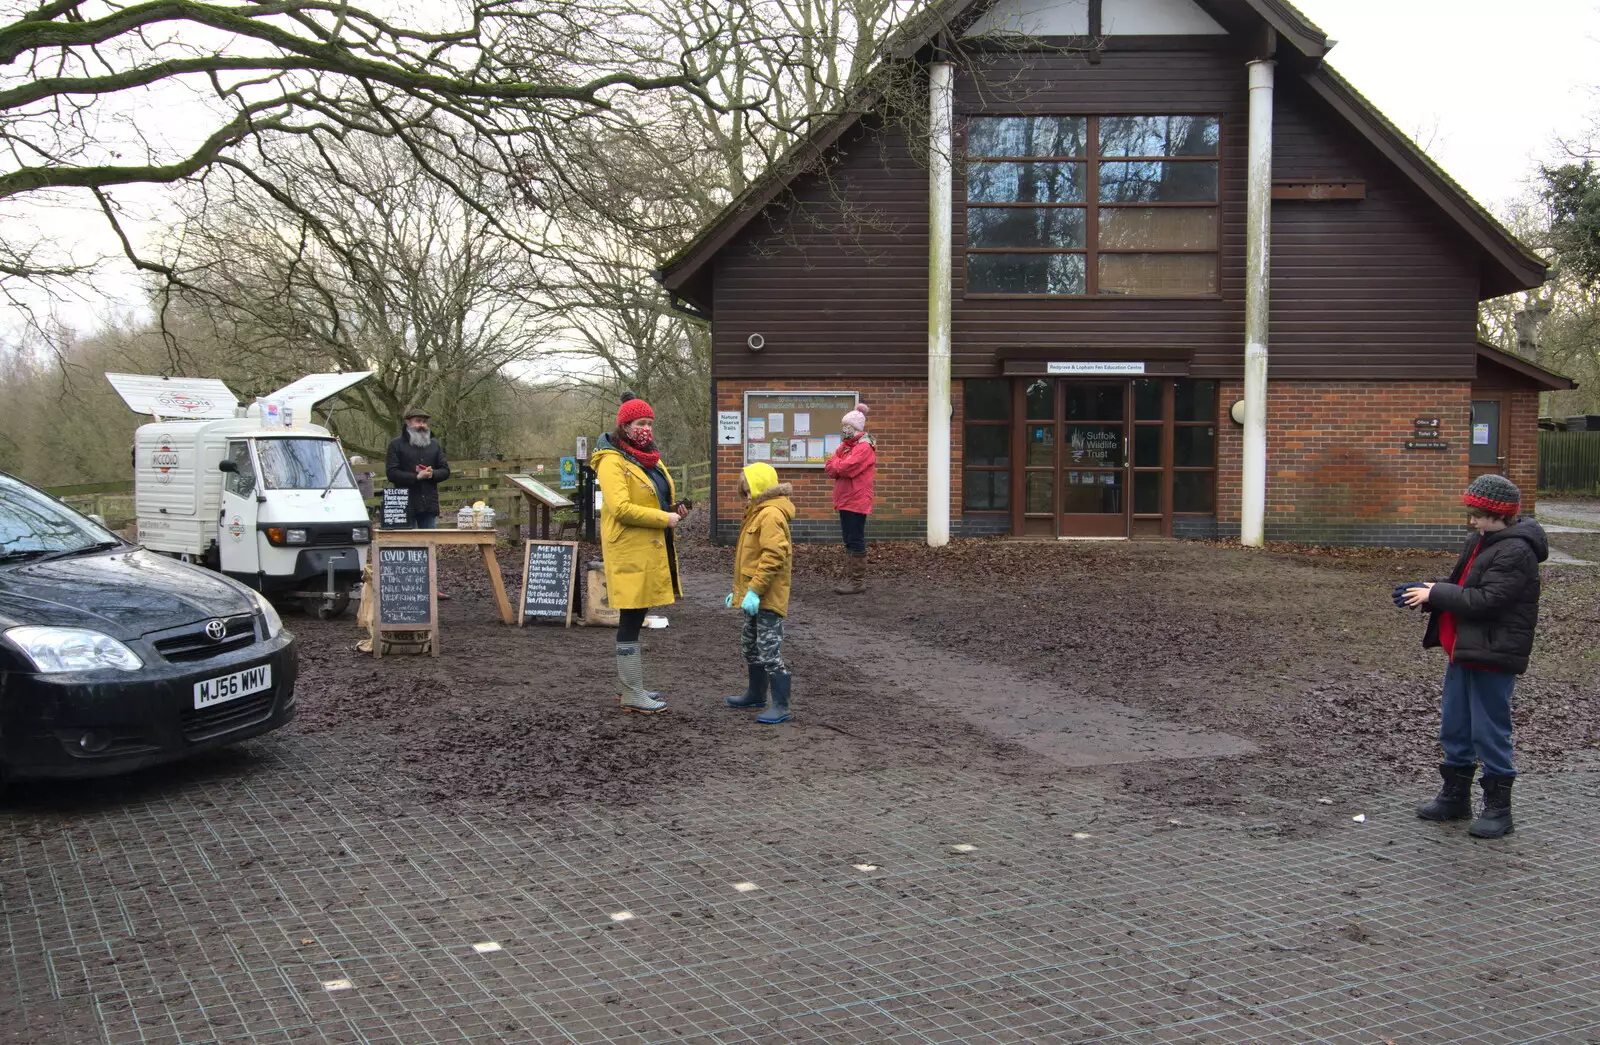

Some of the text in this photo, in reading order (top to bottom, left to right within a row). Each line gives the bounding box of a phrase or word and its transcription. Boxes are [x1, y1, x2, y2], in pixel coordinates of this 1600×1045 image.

[152, 454, 178, 465] PICCOLO
[380, 550, 405, 561] COVID
[407, 550, 422, 561] TIER
[200, 667, 265, 702] MJ56 WMV
